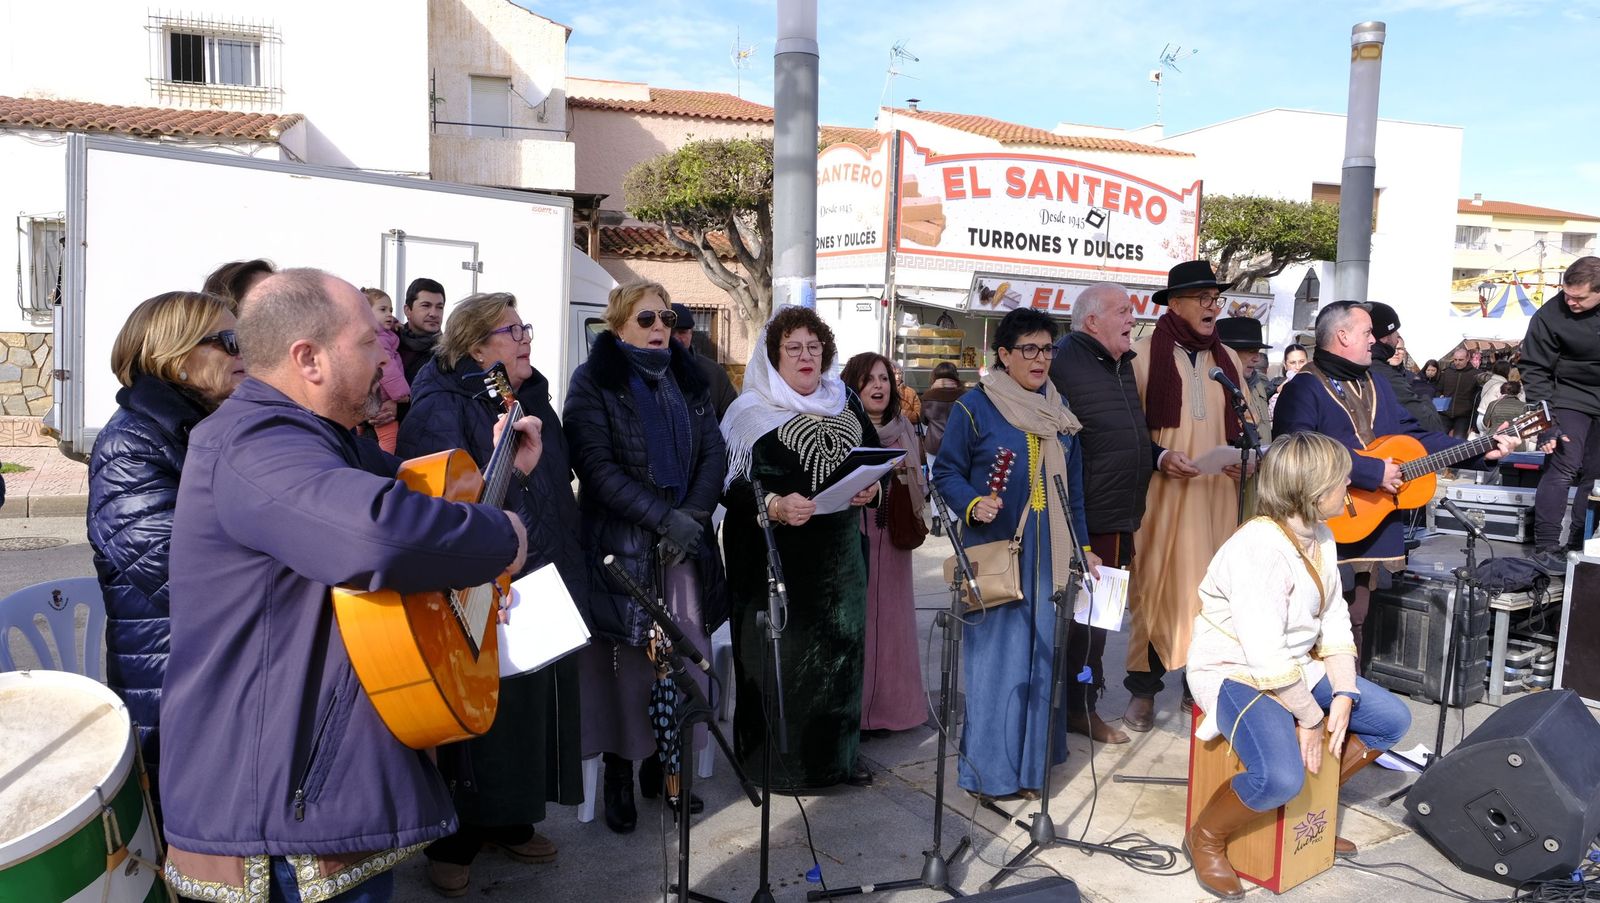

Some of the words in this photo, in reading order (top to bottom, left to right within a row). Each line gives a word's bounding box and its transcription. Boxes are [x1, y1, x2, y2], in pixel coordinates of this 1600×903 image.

[942, 166, 991, 201] EL
[1005, 166, 1168, 225] SANTERO
[1039, 208, 1066, 226] Desde
[1068, 215, 1086, 230] 1945
[837, 234, 843, 248] Y
[844, 230, 877, 247] DULCES
[968, 227, 1063, 254] TURRONES
[1067, 237, 1079, 255] Y
[1084, 239, 1144, 262] DULCES
[1032, 286, 1072, 311] EL
